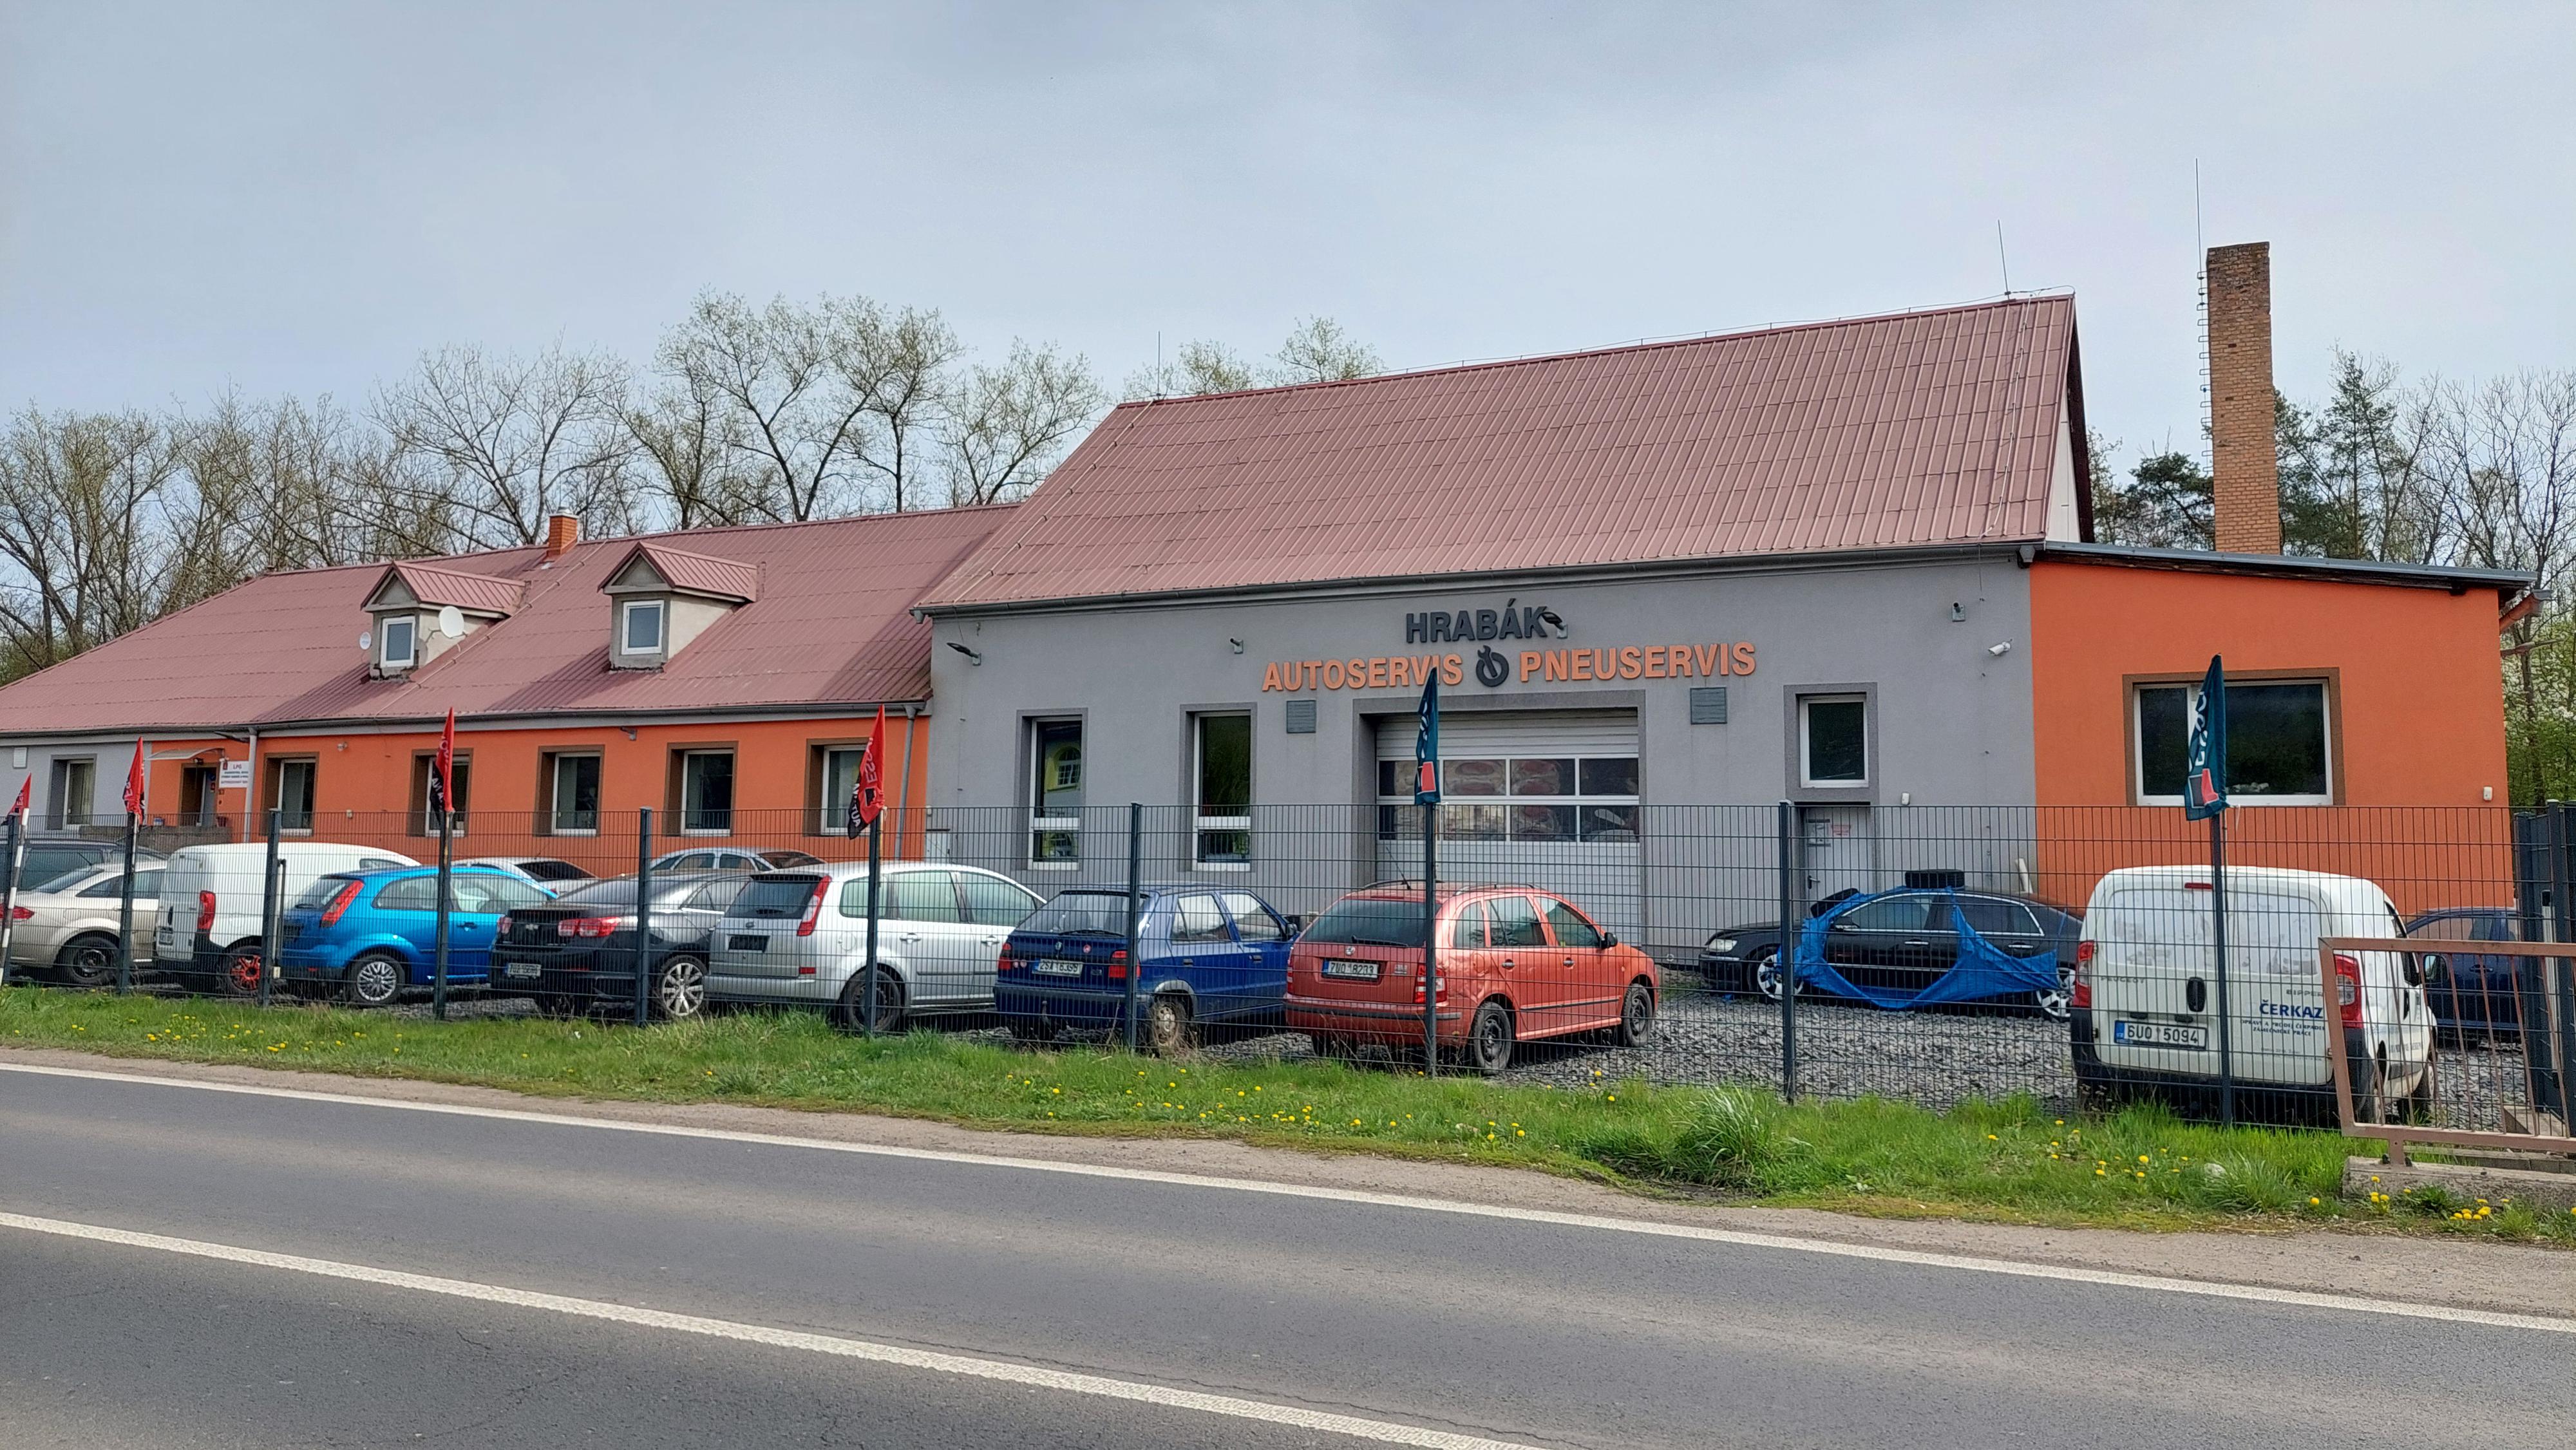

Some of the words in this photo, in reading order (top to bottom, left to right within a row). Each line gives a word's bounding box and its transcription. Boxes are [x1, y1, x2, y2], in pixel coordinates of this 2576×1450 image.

[1406, 598, 1548, 643] HRABÁK
[1262, 652, 1463, 692] AUTOSERVIS
[1520, 641, 1756, 683] PNEUSERVIS
[2259, 999, 2324, 1019] ČERKAZ
[2163, 1028, 2199, 1044] 5094
